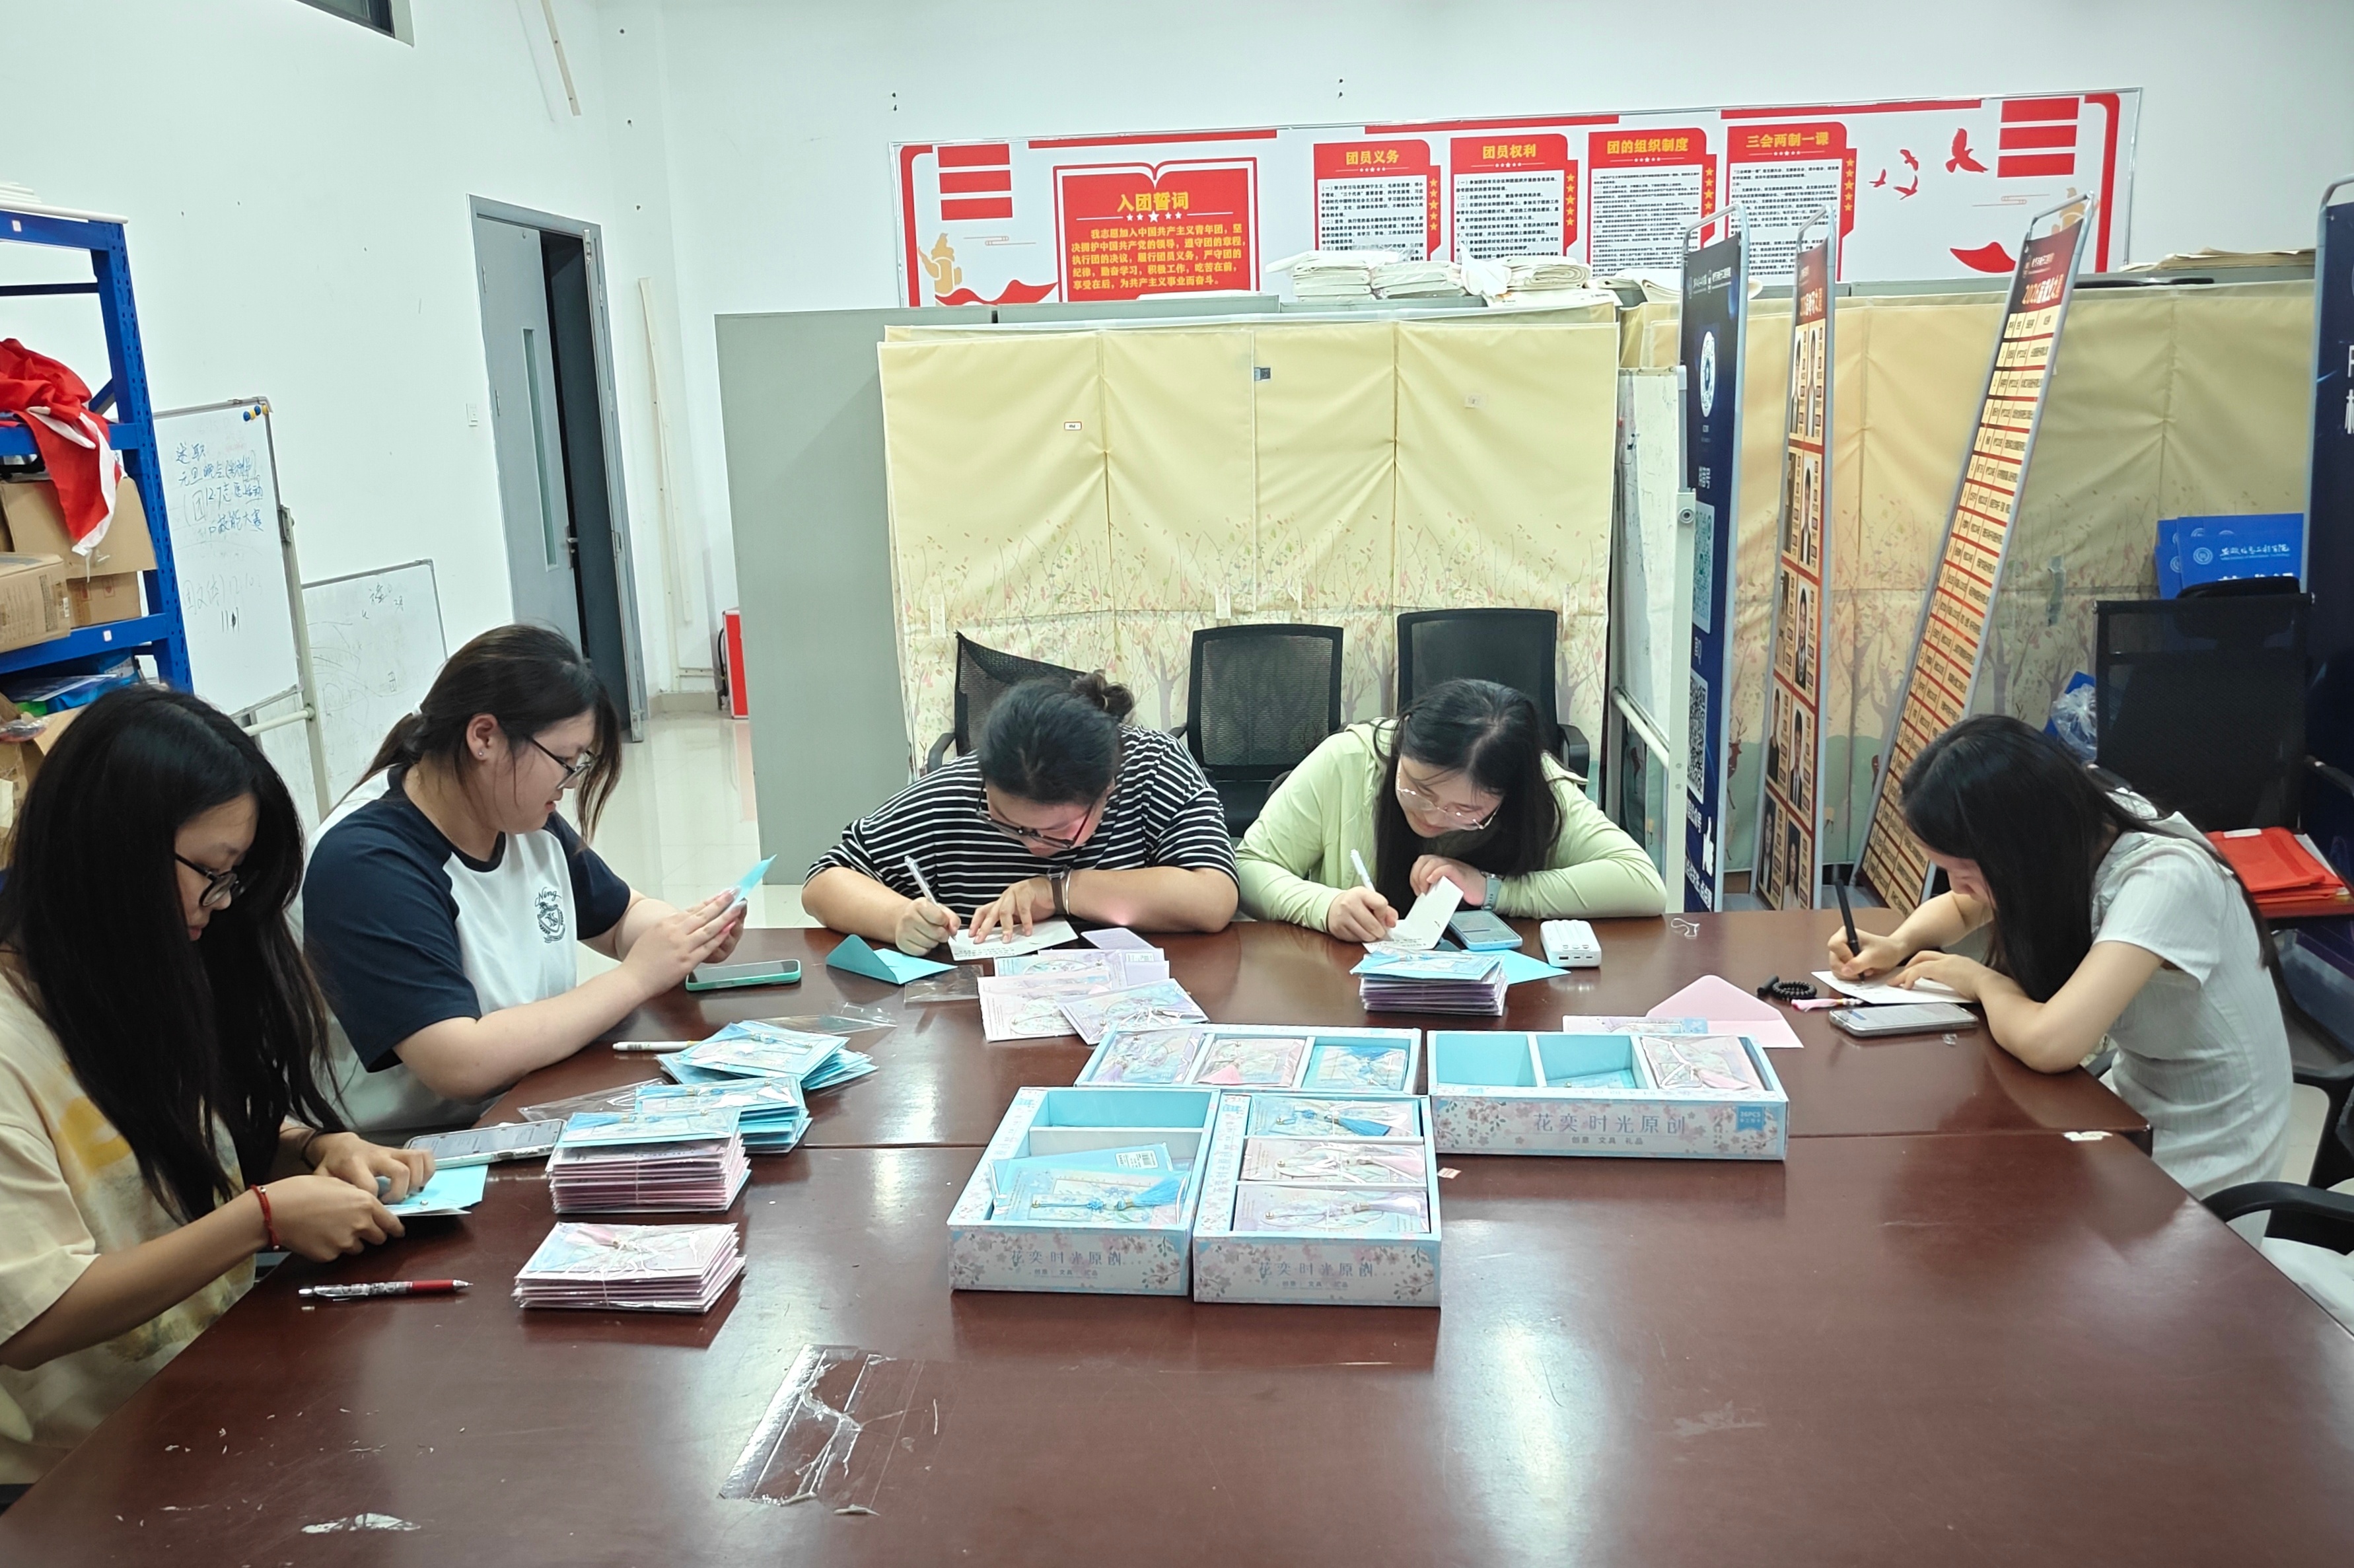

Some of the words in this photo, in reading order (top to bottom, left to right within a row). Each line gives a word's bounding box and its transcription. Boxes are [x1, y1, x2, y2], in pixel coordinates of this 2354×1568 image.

[1606, 137, 1690, 155] 团的组织制度
[1746, 131, 1830, 149] 三会两制一课
[1345, 149, 1400, 166] 团员义务
[1482, 143, 1537, 160] 团员权利
[1117, 192, 1189, 212] 入团誓词
[1091, 223, 1242, 239] 我志愿加入中国共产主义青年团，坚
[1071, 236, 1246, 253] 决拥护中国共产党的领导，遵守团的章程，
[1072, 249, 1242, 265] 执行团的决议，履行团员义务，严守团的
[1073, 262, 1237, 277] 纪律，勤奋学习，积极工作，吃苦在前，
[1073, 275, 1219, 290] 享受在后，为共产主义事业而奋斗。
[535, 886, 562, 907] Ning
[1533, 1114, 1686, 1135] 花奕时光原创
